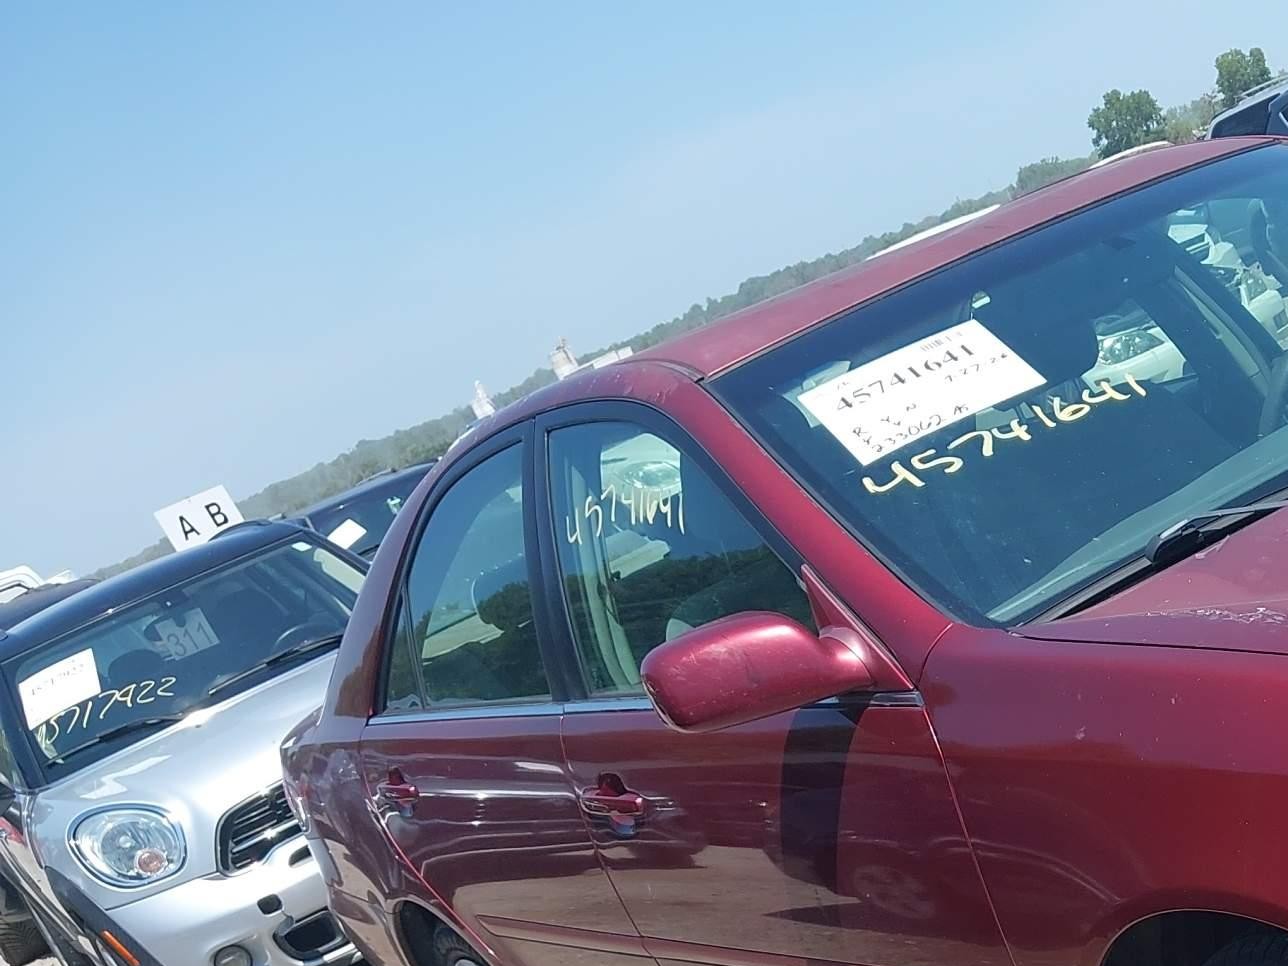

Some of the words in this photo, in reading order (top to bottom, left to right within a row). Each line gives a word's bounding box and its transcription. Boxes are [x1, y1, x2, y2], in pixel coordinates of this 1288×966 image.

[836, 344, 974, 411] 45741641
[862, 373, 1147, 494] 45741641
[178, 515, 201, 541] A
[204, 502, 229, 528] B
[565, 483, 686, 545] 45741641
